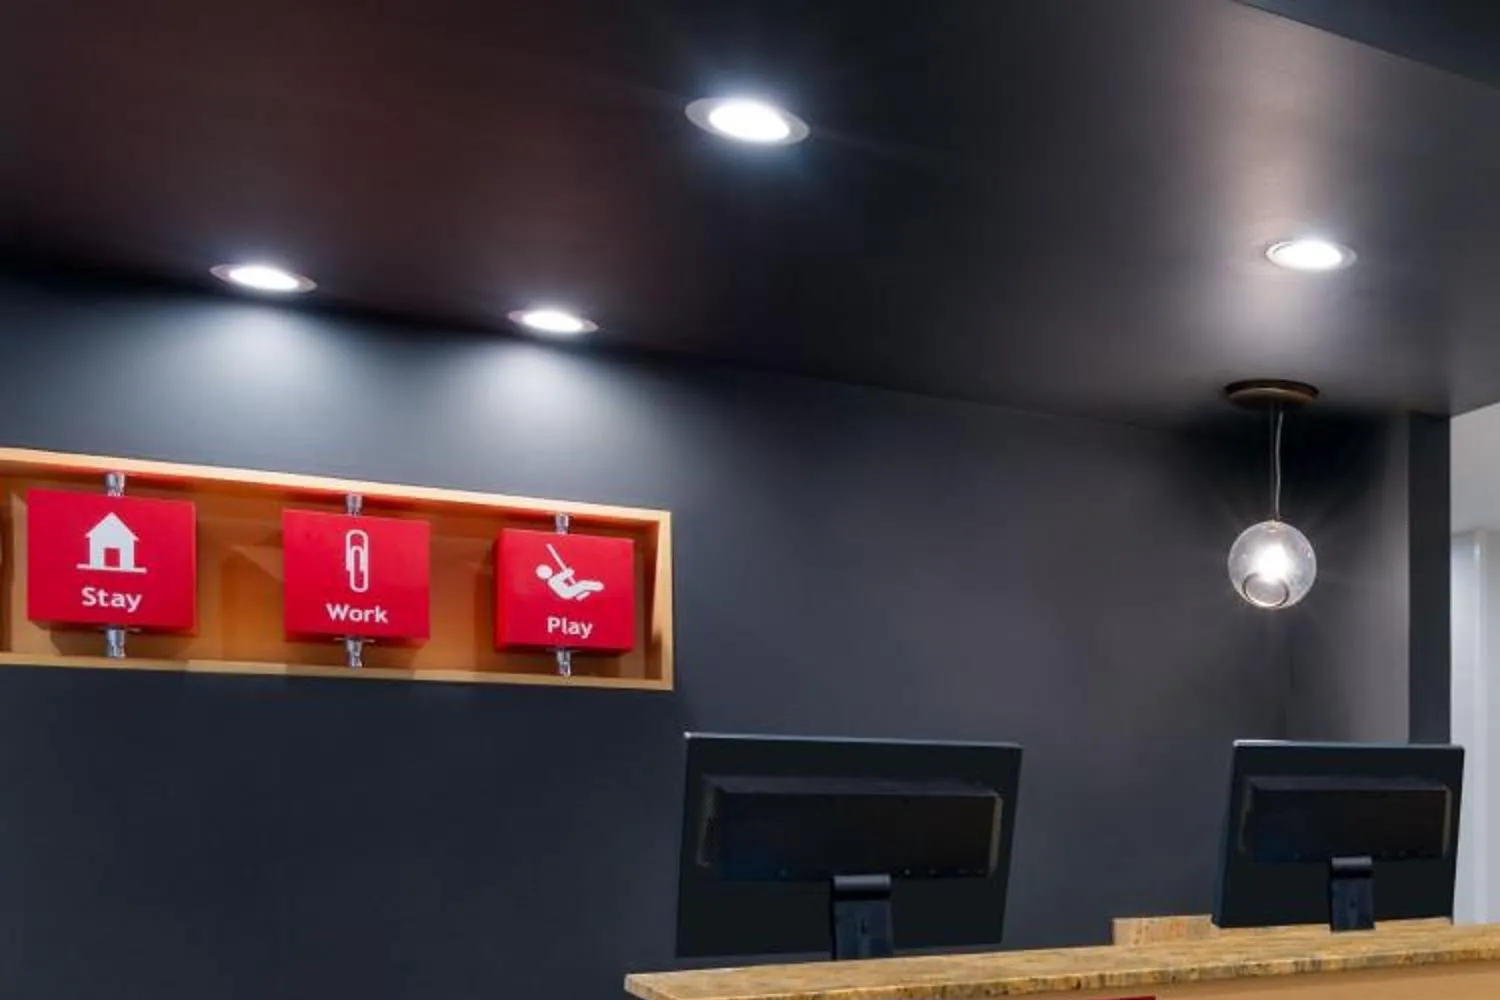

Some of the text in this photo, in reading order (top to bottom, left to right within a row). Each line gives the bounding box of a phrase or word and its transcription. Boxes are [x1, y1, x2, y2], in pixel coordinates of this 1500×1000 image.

[81, 586, 142, 612] Stay
[325, 602, 389, 625] Work
[546, 615, 594, 639] Play
